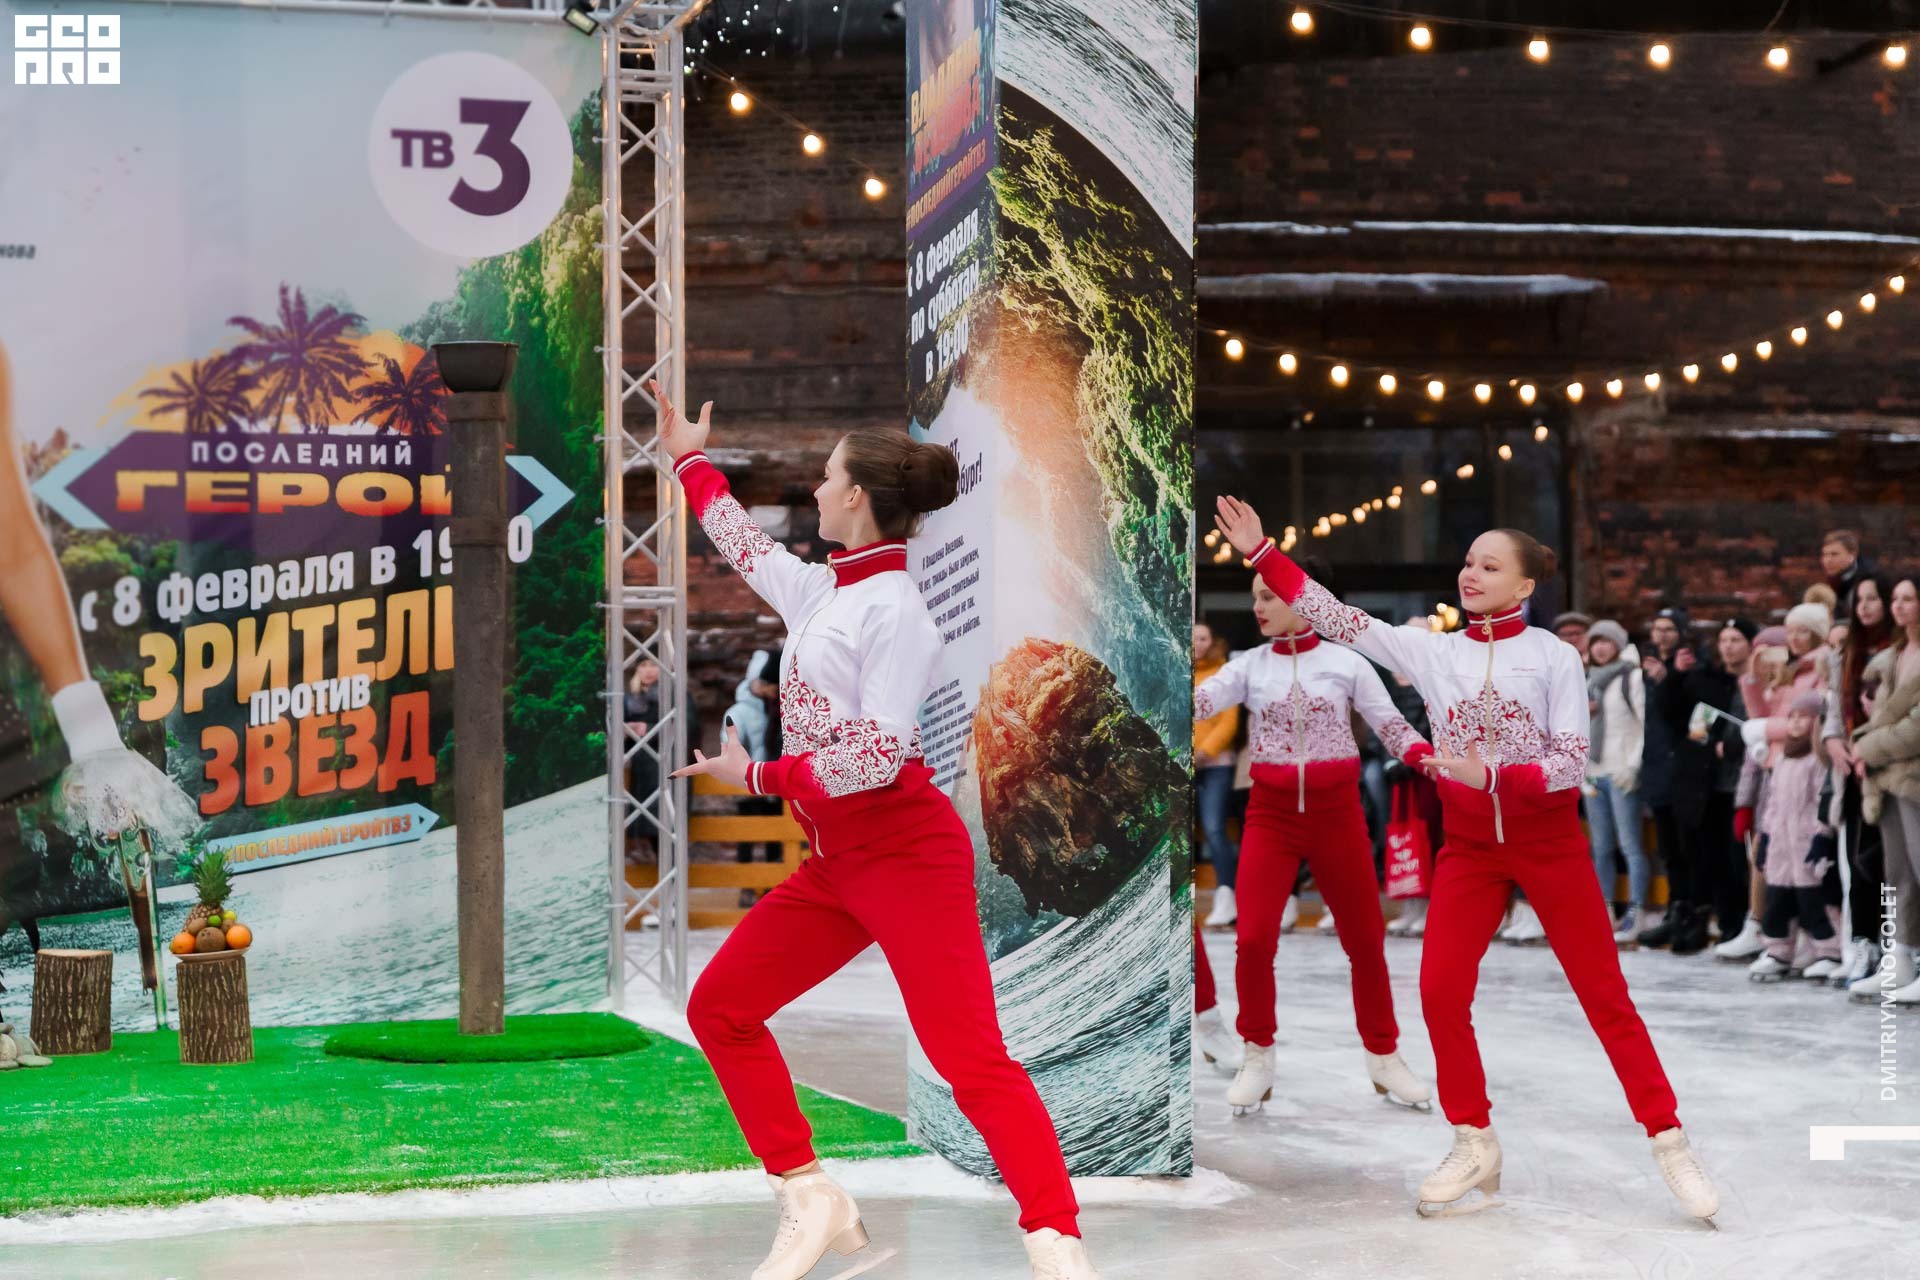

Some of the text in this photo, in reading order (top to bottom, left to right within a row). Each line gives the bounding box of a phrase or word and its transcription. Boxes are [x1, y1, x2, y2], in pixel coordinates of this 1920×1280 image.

[915, 250, 924, 291] 8
[926, 207, 979, 284] февраля
[911, 258, 979, 345] по субботам
[925, 350, 934, 383] в
[191, 440, 412, 467] ПОСЛЕДНИЙ
[112, 575, 142, 627] 8
[157, 551, 354, 624] февраля
[370, 545, 397, 586] в
[250, 673, 371, 728] ПРОТИВ
[201, 690, 436, 815] ЗВЕЗД
